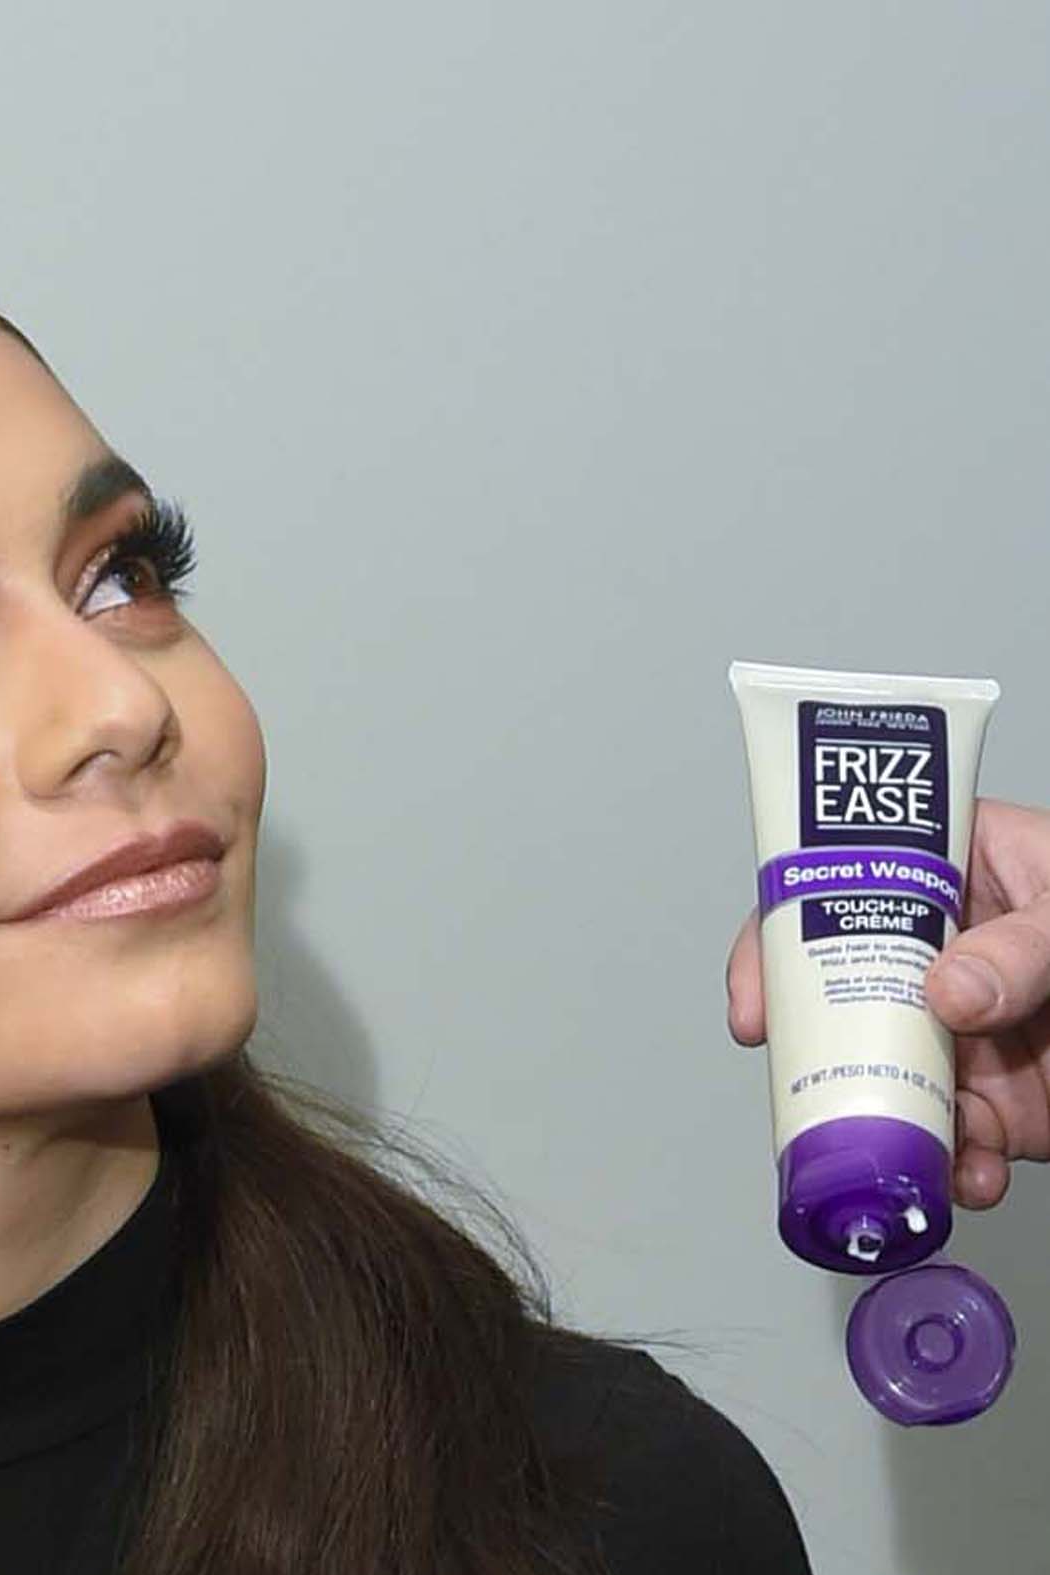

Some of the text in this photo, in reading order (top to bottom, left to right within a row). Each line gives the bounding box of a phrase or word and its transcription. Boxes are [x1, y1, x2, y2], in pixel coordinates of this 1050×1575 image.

[816, 708, 929, 723] JOHN FRIEDA
[815, 745, 933, 787] FRIZZ
[783, 861, 959, 905] Secret Weapon
[821, 899, 930, 918] TOUCH-UP
